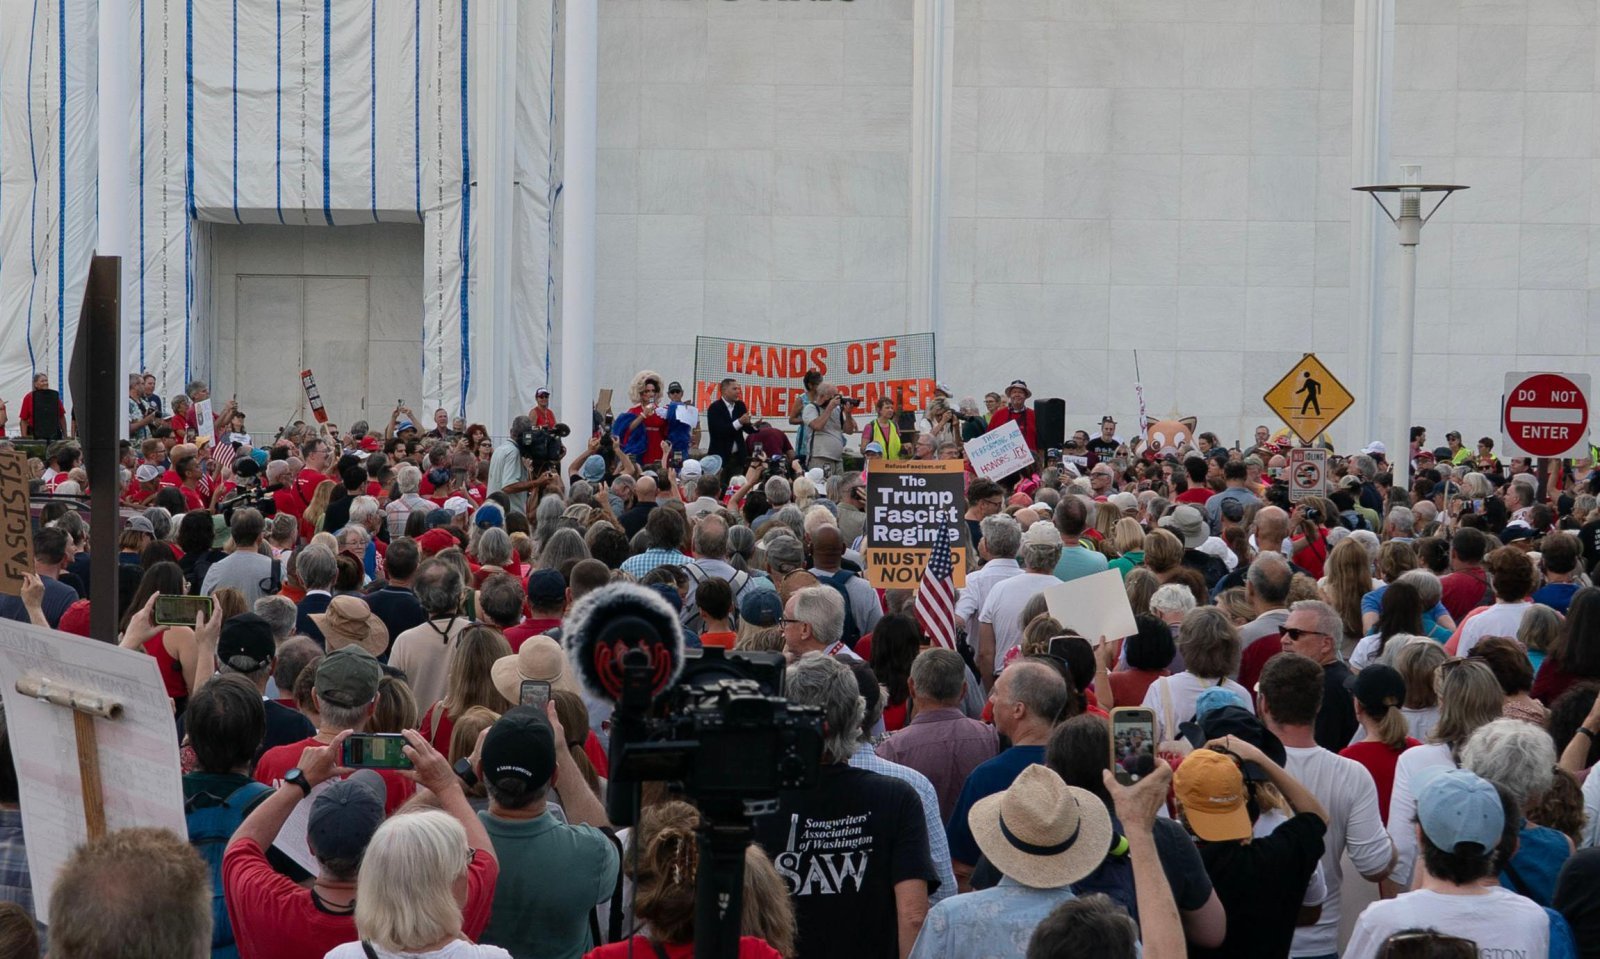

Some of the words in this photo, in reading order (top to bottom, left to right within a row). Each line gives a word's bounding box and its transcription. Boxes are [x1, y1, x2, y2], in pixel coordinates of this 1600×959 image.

[727, 342, 828, 379] HANDS
[847, 339, 897, 374] OFF
[1518, 389, 1537, 402] DO
[1550, 390, 1577, 403] NOT
[1522, 425, 1569, 440] ENTER
[1012, 444, 1027, 460] JFK
[884, 463, 947, 471] RefuseFascism.org
[899, 475, 927, 487] The
[877, 487, 954, 509] Trump
[874, 506, 958, 523] Fascist
[873, 552, 927, 566] MUST
[804, 811, 872, 830] Songwriters'
[801, 826, 862, 839] Association
[799, 840, 812, 852] of
[813, 836, 873, 849] Washington
[774, 848, 873, 896] SAW
